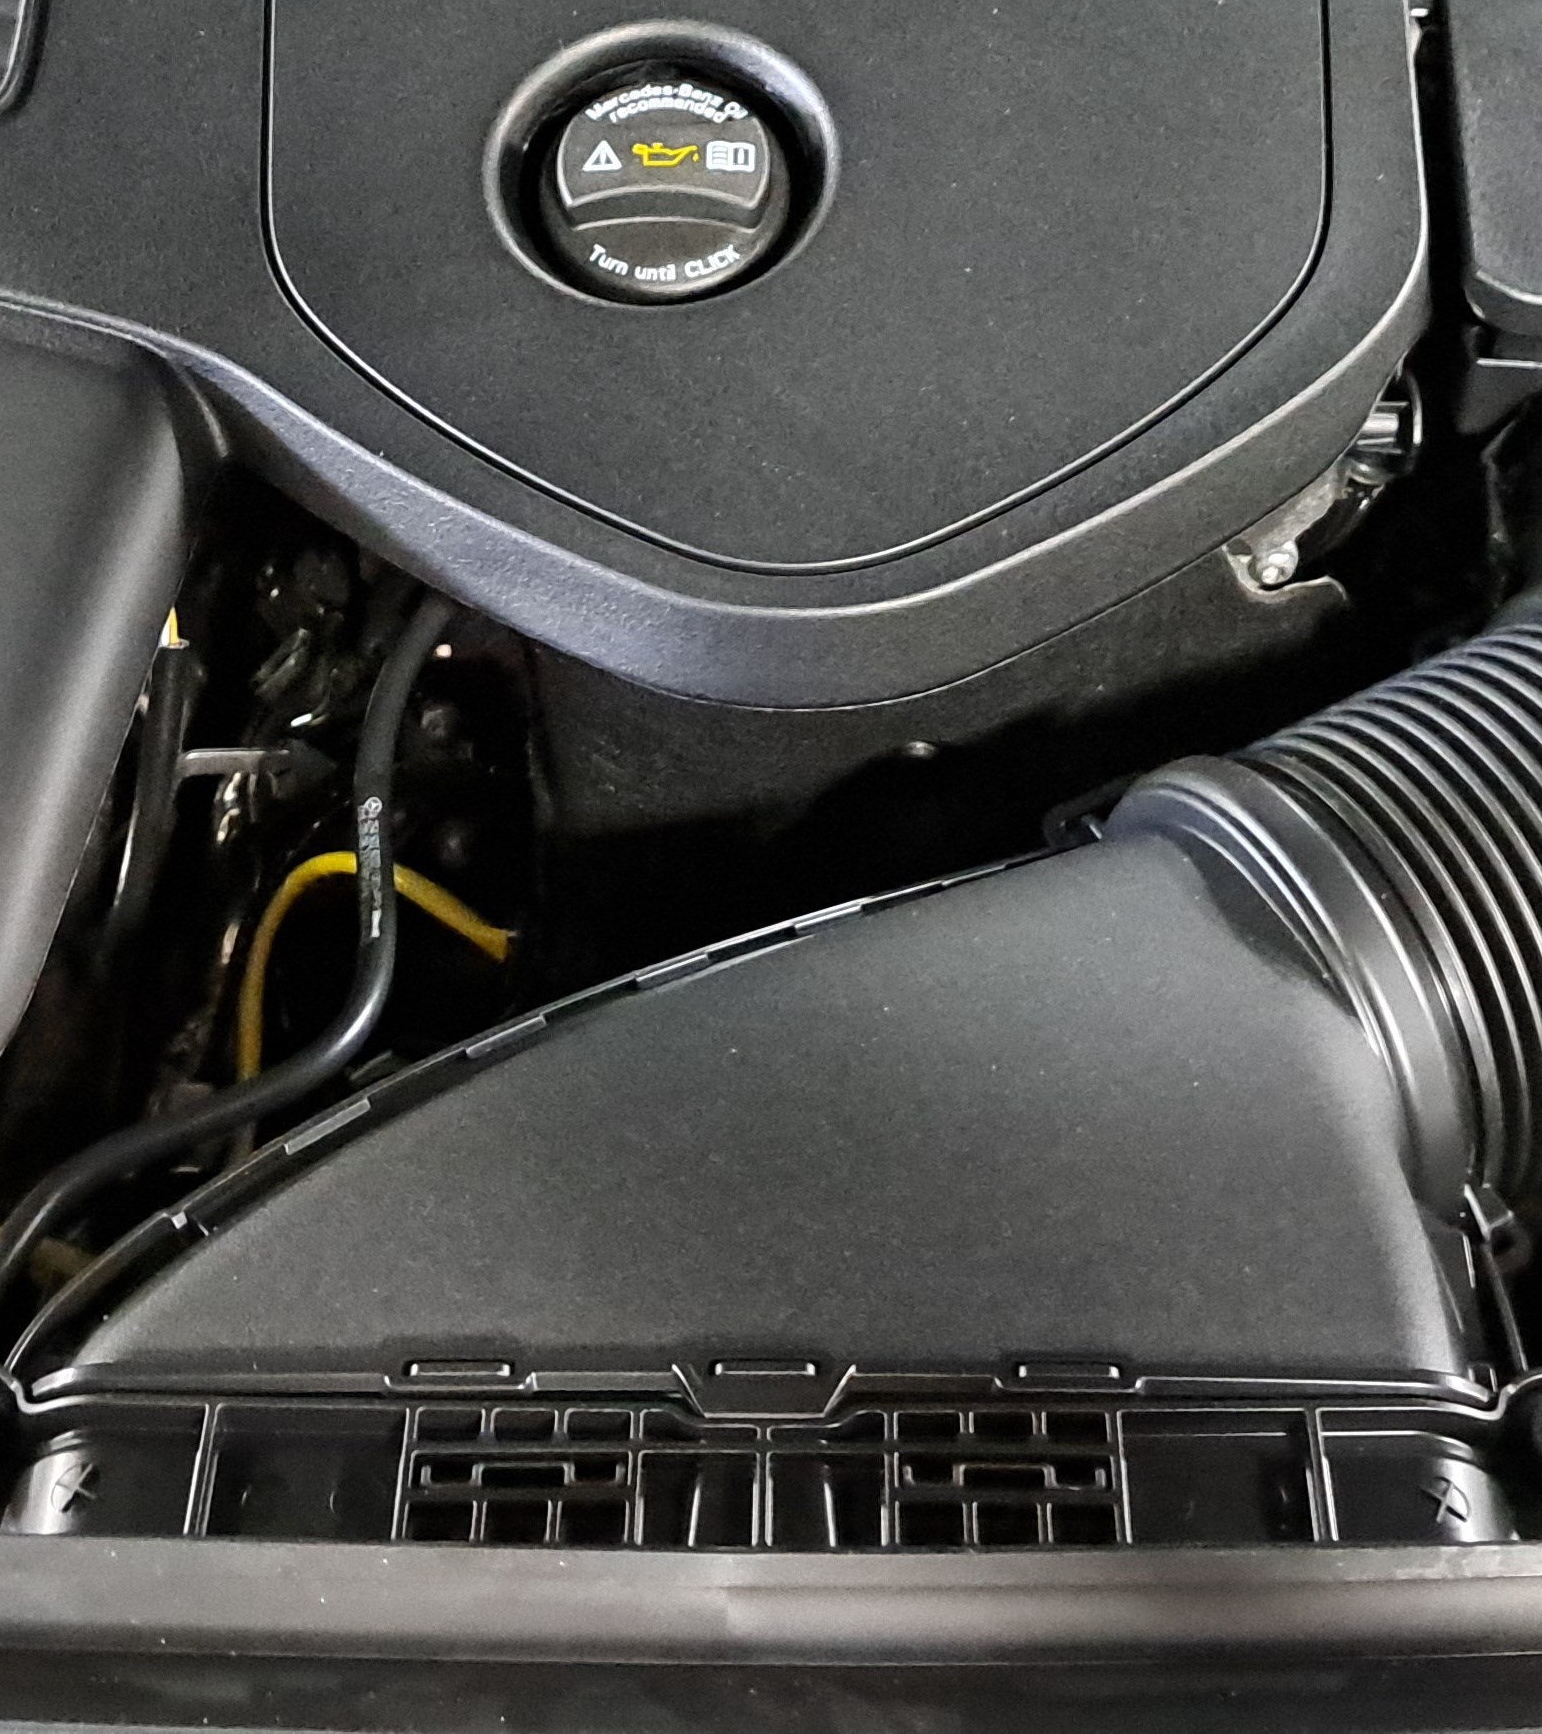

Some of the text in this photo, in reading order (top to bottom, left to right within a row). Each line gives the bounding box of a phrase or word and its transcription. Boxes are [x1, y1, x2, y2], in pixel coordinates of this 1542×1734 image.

[585, 83, 724, 120] Mercedes-Benz
[609, 97, 726, 124] recommended
[589, 243, 741, 281] Turn until CLICK
